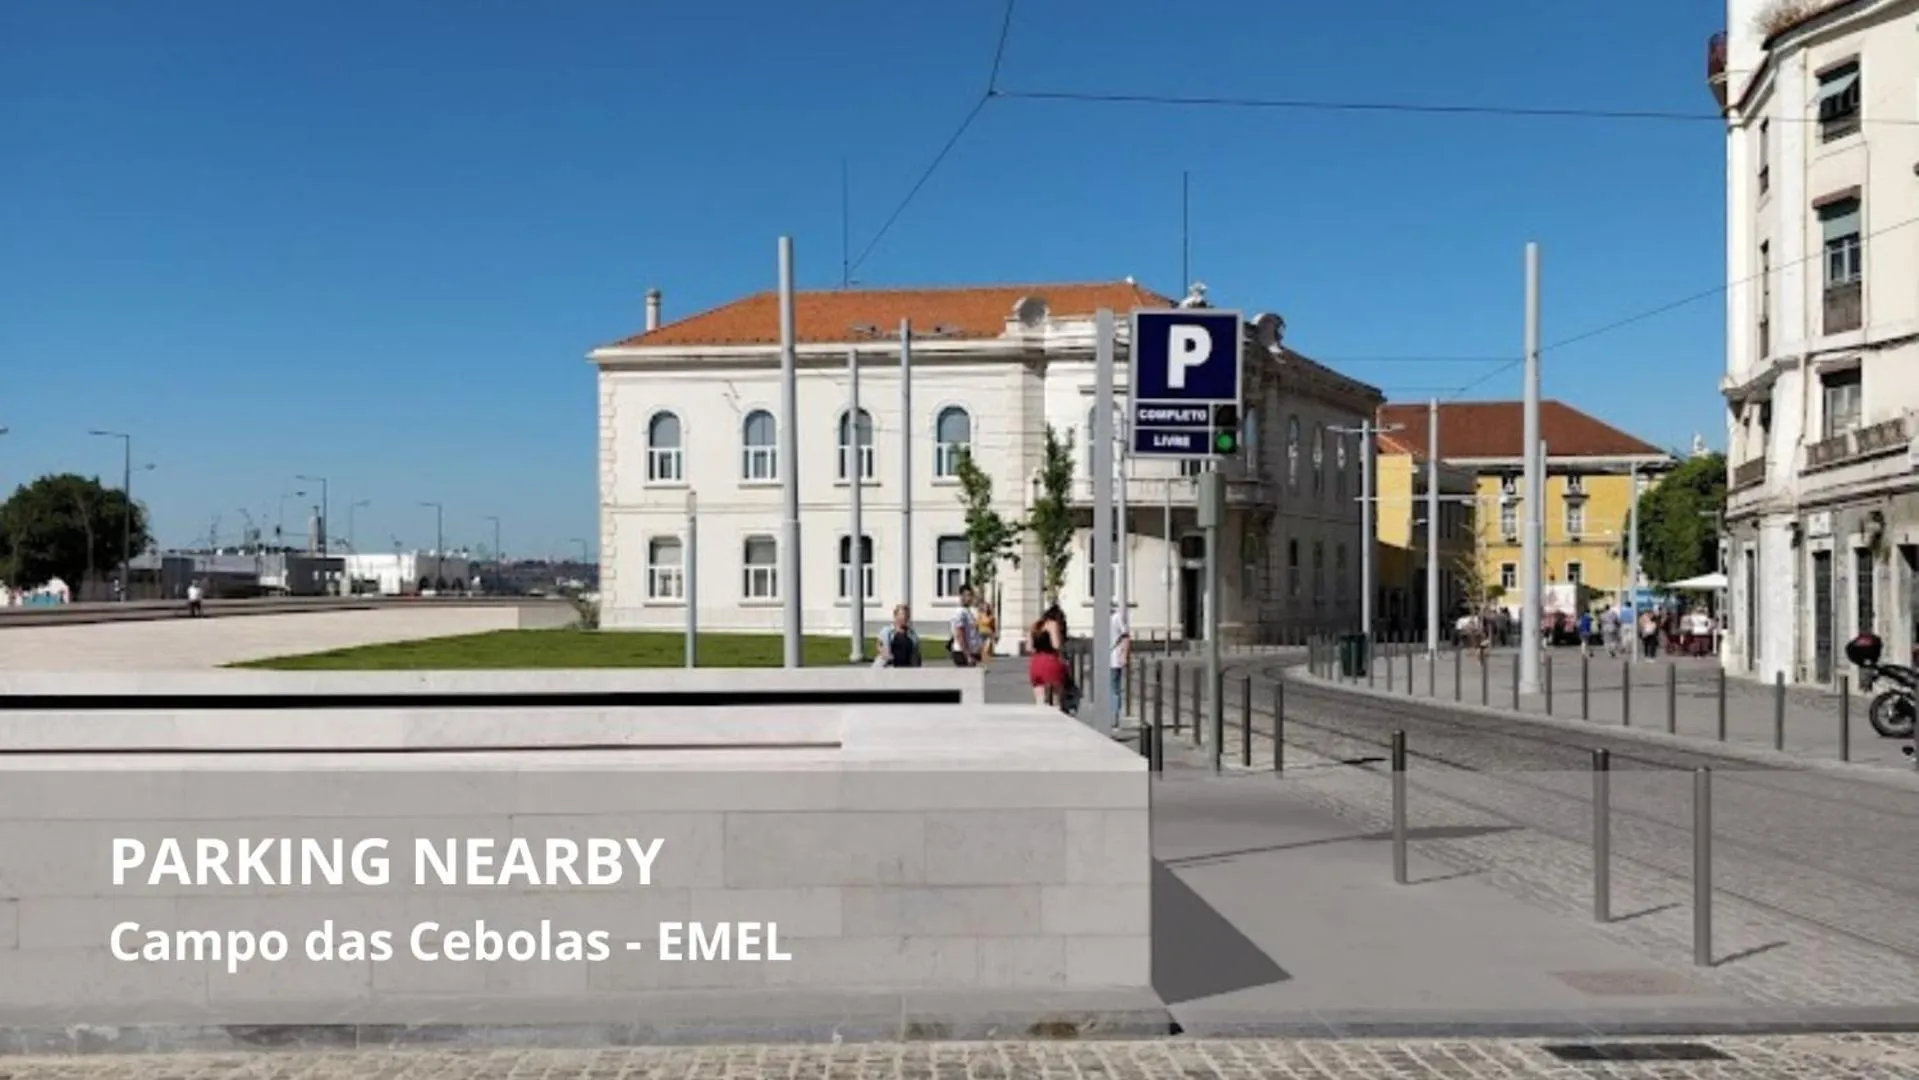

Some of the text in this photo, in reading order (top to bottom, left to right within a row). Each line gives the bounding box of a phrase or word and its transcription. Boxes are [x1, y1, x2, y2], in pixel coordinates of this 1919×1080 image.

[1167, 324, 1212, 389] P
[1139, 409, 1207, 421] COMPLETO
[1153, 434, 1190, 447] LIVRE
